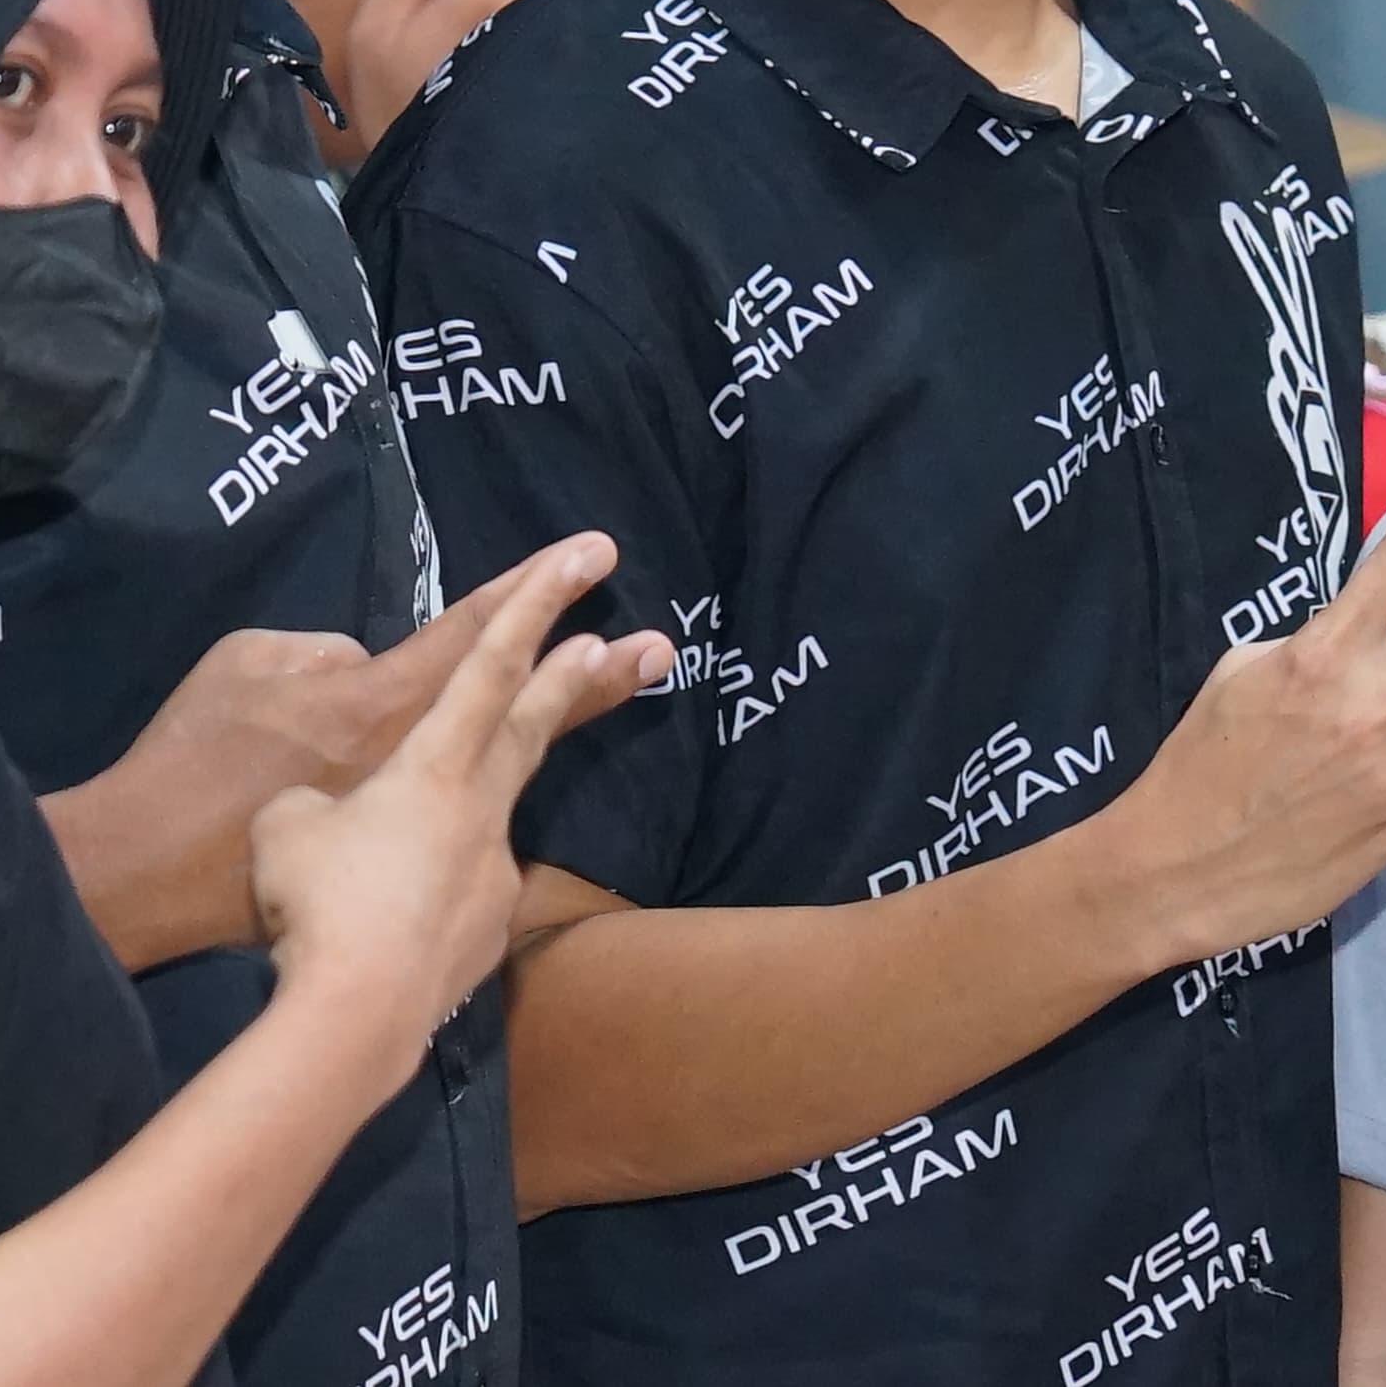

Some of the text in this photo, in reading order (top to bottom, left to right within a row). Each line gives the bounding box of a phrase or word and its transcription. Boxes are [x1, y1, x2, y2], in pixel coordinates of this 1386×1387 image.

[715, 264, 793, 345] YES
[207, 340, 376, 527] DIRHAM
[1012, 371, 1165, 532] DIRHAM
[867, 725, 1115, 899] DIRHAM
[926, 721, 1032, 822] YES
[725, 1109, 1018, 1275] DIRHAM
[1105, 1207, 1220, 1302] YES
[358, 1264, 455, 1361] YES
[1059, 1227, 1274, 1387] DIRHAM
